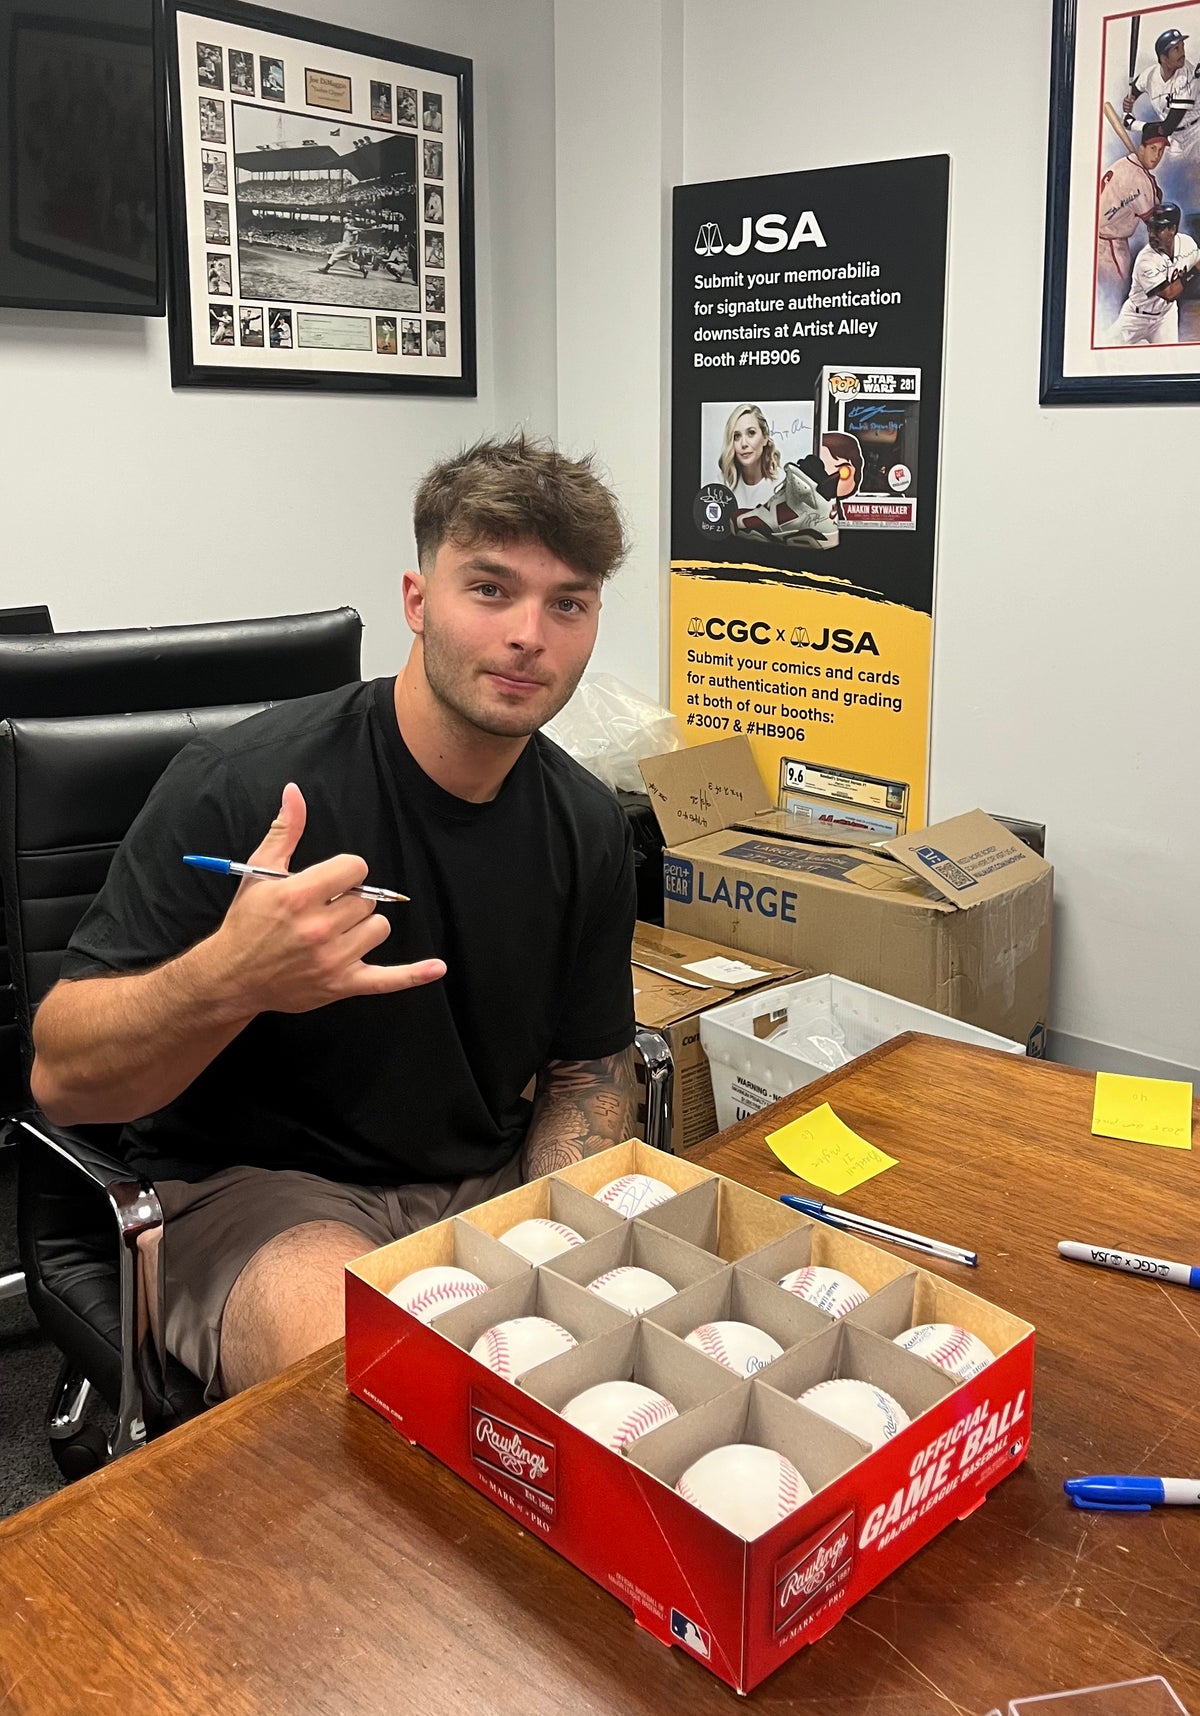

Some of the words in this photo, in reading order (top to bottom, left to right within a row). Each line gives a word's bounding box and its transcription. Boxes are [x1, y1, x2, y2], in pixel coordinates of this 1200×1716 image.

[724, 211, 827, 256] JSA
[694, 271, 744, 289] Submit
[747, 270, 780, 289] your
[784, 261, 880, 284] memorabilia
[694, 301, 714, 316] for
[717, 296, 784, 318] signature
[788, 288, 902, 310] authentication
[693, 324, 771, 342] downstairs
[774, 322, 789, 338] at
[792, 320, 834, 337] Artist
[837, 319, 878, 338] Alley
[694, 351, 735, 367] Booth
[739, 349, 801, 366] #HB906
[828, 375, 859, 394] POP!
[863, 375, 897, 384] STAR
[900, 378, 915, 391] 281
[863, 383, 897, 393] WARS
[847, 505, 870, 514] ANAKIN
[871, 505, 908, 515] SKYWALKER
[705, 617, 771, 645] CGC
[811, 627, 880, 656] JSA
[687, 649, 734, 667] Submit
[737, 657, 768, 671] your
[771, 660, 821, 677] comics
[826, 664, 853, 681] and
[858, 668, 900, 685] cards
[687, 671, 705, 685] for
[708, 674, 807, 698] authentication
[811, 685, 839, 702] and
[843, 690, 902, 712] grading
[687, 694, 700, 705] at
[703, 694, 733, 710] both
[736, 699, 750, 712] of
[754, 704, 777, 716] our
[781, 704, 835, 723] booths:
[686, 713, 729, 731] #3007
[733, 719, 743, 732] &
[746, 721, 805, 741] #HB906
[788, 767, 804, 783] 9.6
[753, 844, 798, 857] LARGE
[666, 875, 688, 897] GEAR
[698, 872, 798, 924] LARGE
[736, 1076, 768, 1097] WARNING
[1091, 1249, 1111, 1263] JSA
[1133, 1258, 1158, 1273] CGC
[476, 1417, 549, 1480] Rawlings
[909, 1398, 990, 1478] OFFICIAL
[858, 1447, 957, 1550] GAME
[958, 1388, 1026, 1471] BALL
[489, 1480, 516, 1507] MARK
[531, 1512, 551, 1533] PRO
[538, 1498, 554, 1515] 1887
[877, 1510, 918, 1552] MAJOR
[919, 1476, 961, 1518] LEAGUE
[961, 1434, 1008, 1483] BASEBALL
[780, 1532, 849, 1608] Rawlings
[790, 1613, 815, 1640] MARK
[828, 1588, 846, 1607] PRO
